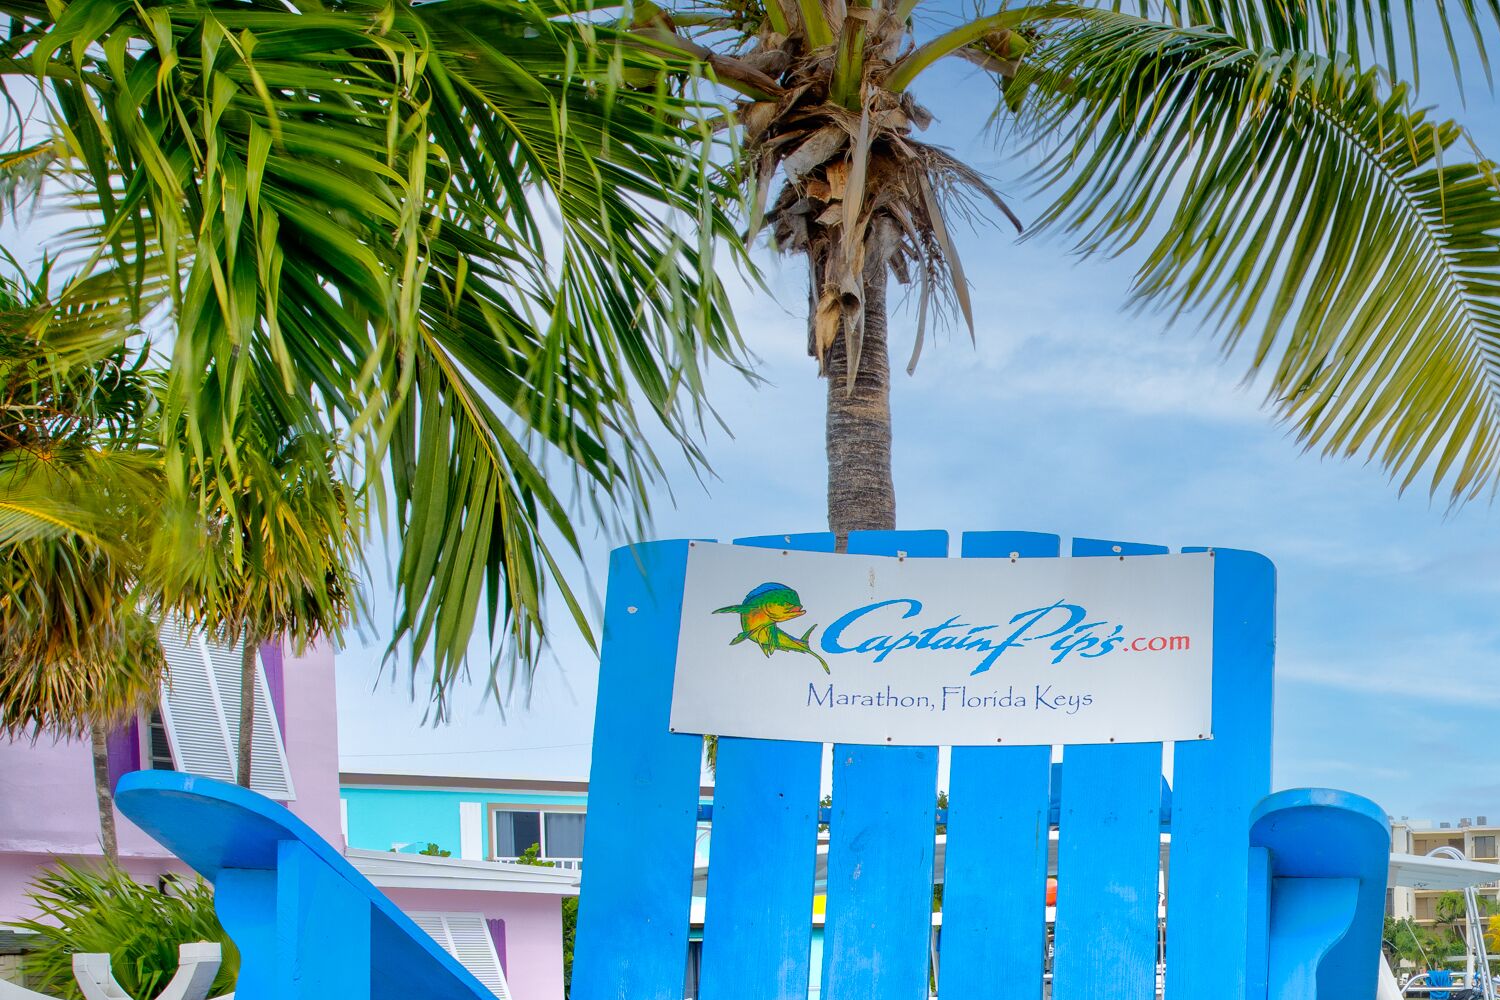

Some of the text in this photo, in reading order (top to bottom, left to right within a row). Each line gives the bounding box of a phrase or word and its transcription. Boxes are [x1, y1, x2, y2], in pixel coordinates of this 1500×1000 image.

[807, 682, 1094, 715] Marathon, Florida Keys
